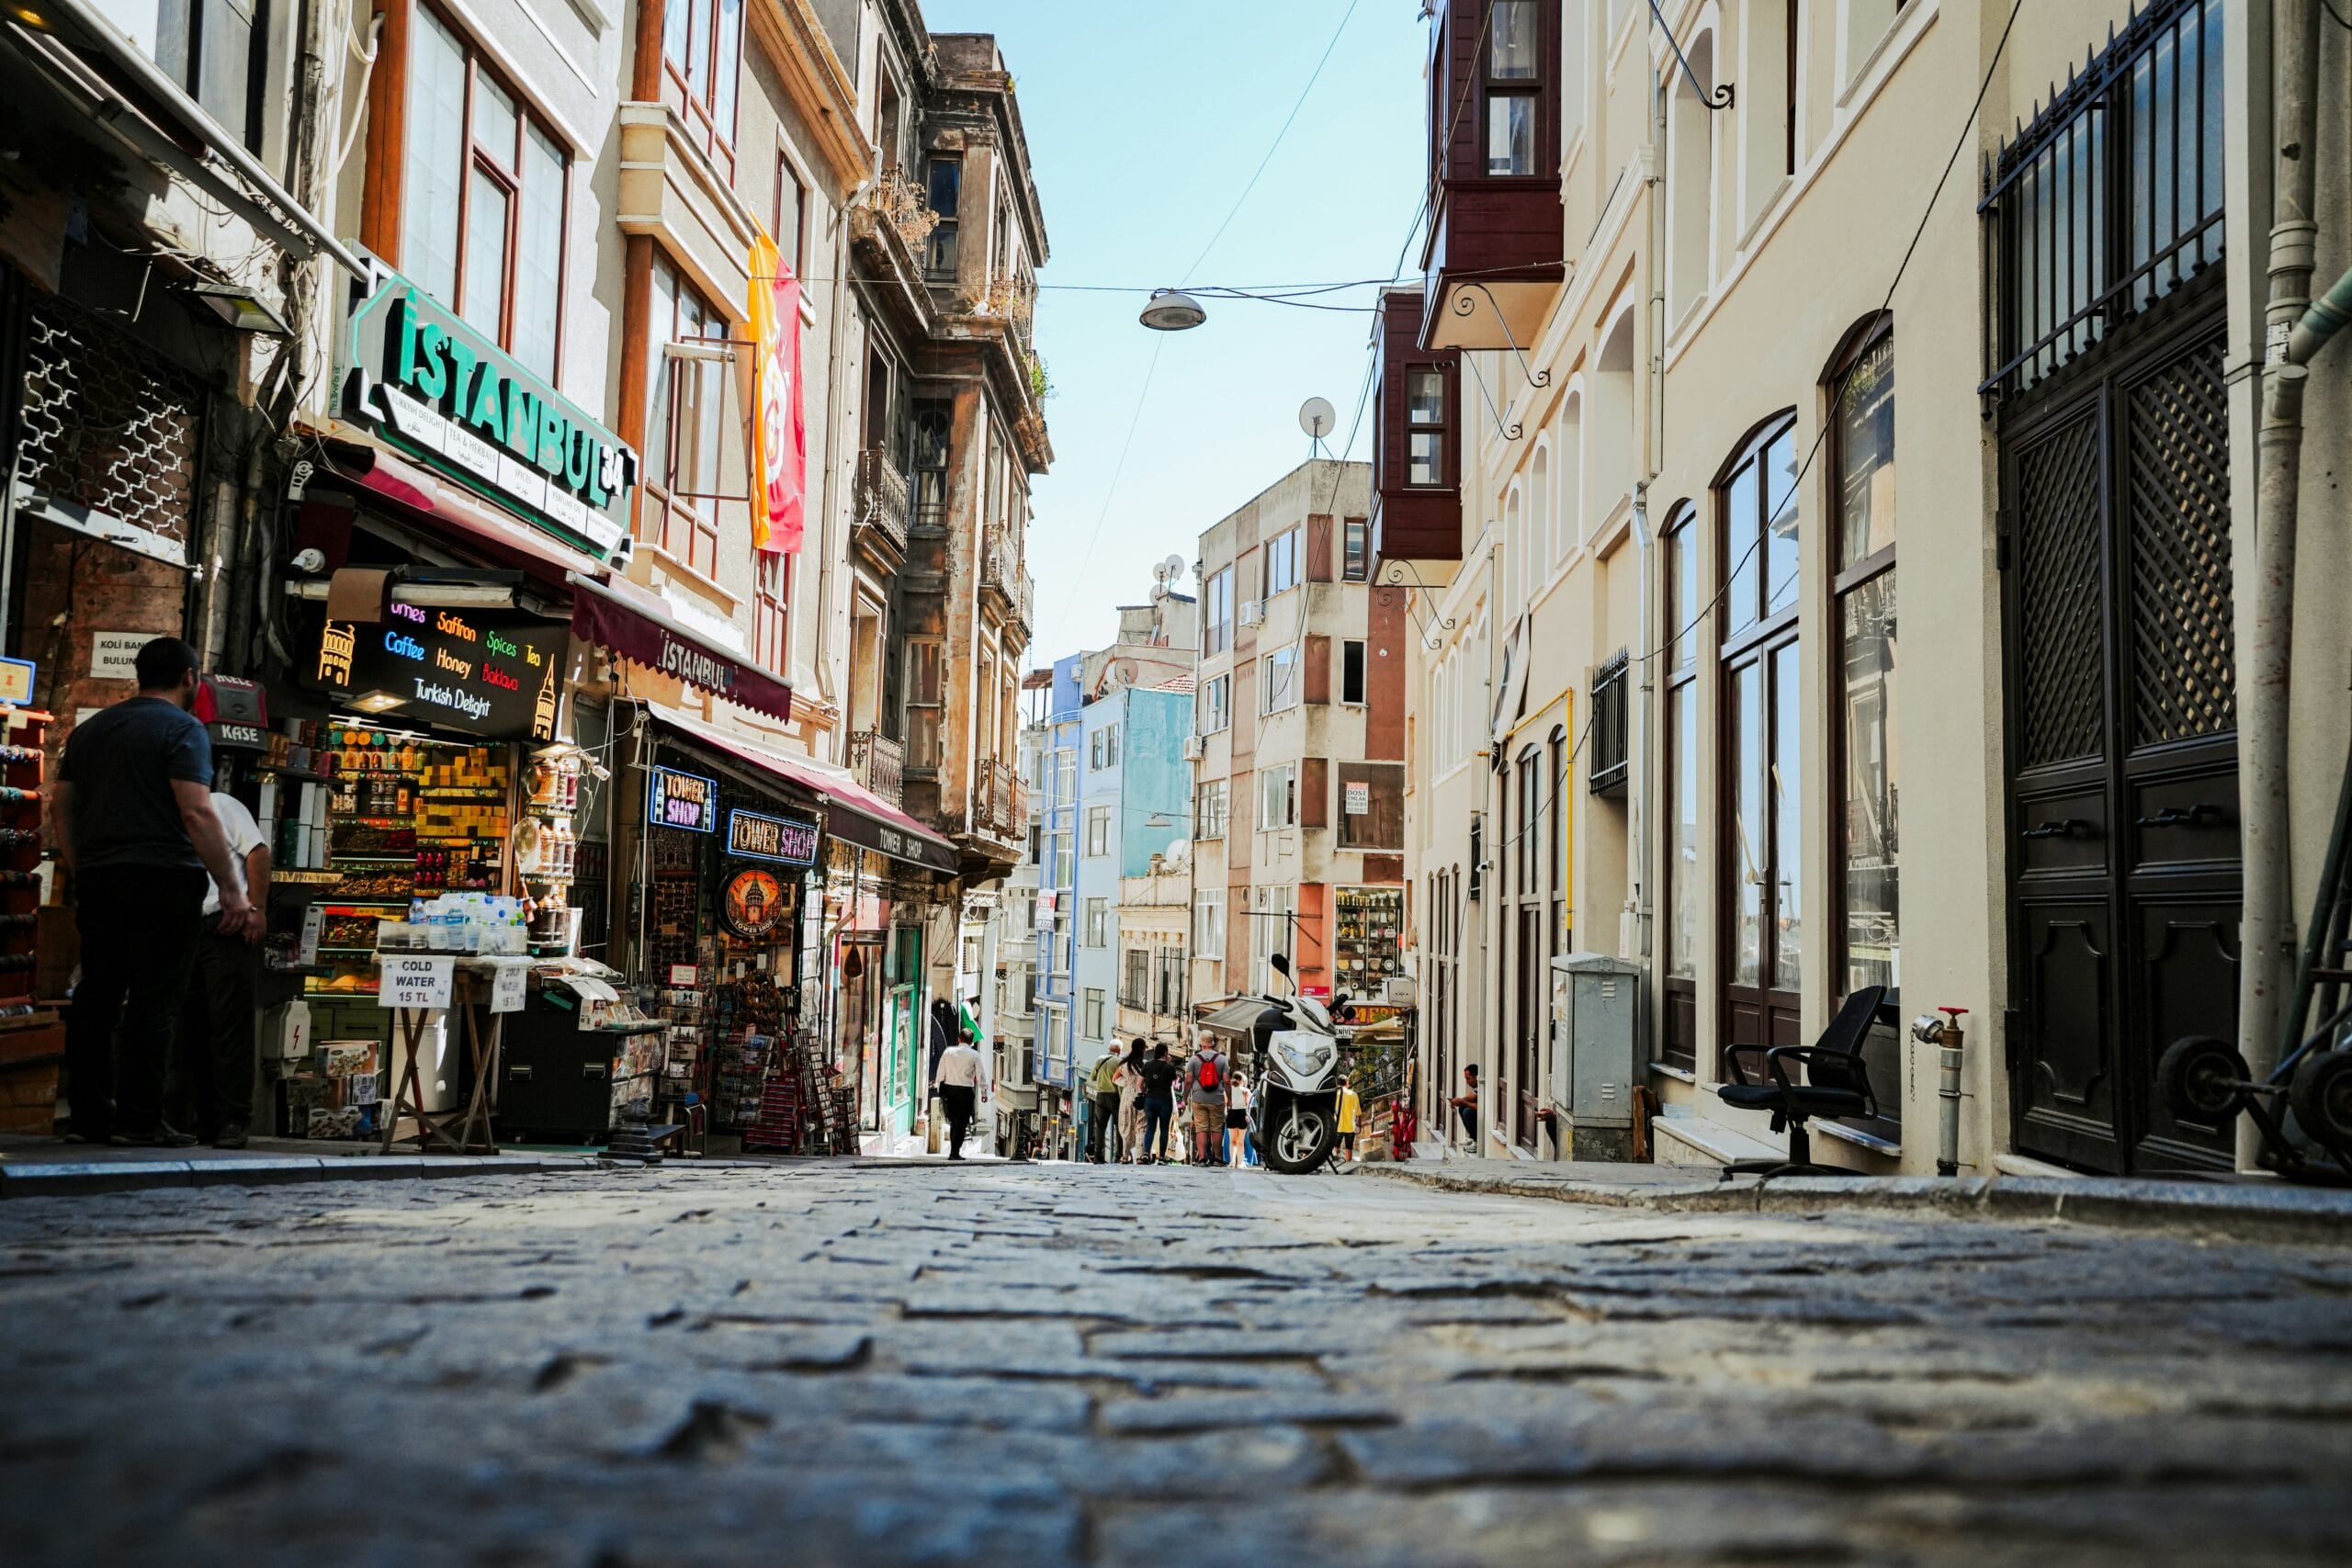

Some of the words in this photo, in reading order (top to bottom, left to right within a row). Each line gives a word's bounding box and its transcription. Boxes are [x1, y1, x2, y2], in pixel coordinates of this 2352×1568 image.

[391, 393, 418, 415] TURKISH
[419, 410, 444, 431] DELIGHT
[449, 428, 461, 442] TEA
[469, 440, 496, 464] HERBALS
[600, 444, 624, 497] 34
[100, 638, 122, 649] KOLİ
[436, 611, 477, 642] Saffron
[486, 630, 517, 657] Spices
[523, 644, 541, 667] Tea
[384, 631, 425, 661] Coffee
[435, 647, 471, 680] Honey
[481, 662, 519, 691] Baklava
[413, 677, 453, 707] Turkish
[454, 688, 492, 720] Delight
[665, 774, 706, 805] TOWER
[666, 798, 700, 826] SHOP
[733, 816, 779, 854] TOWER
[780, 826, 816, 859] SHOP
[879, 829, 900, 853] TOWER
[906, 838, 922, 860] SHOP
[735, 920, 757, 933] TOWER
[758, 919, 774, 932] SHOP
[396, 976, 435, 987] WATER
[401, 961, 433, 972] COLD
[399, 991, 412, 1002] 15
[415, 992, 429, 1002] TL
